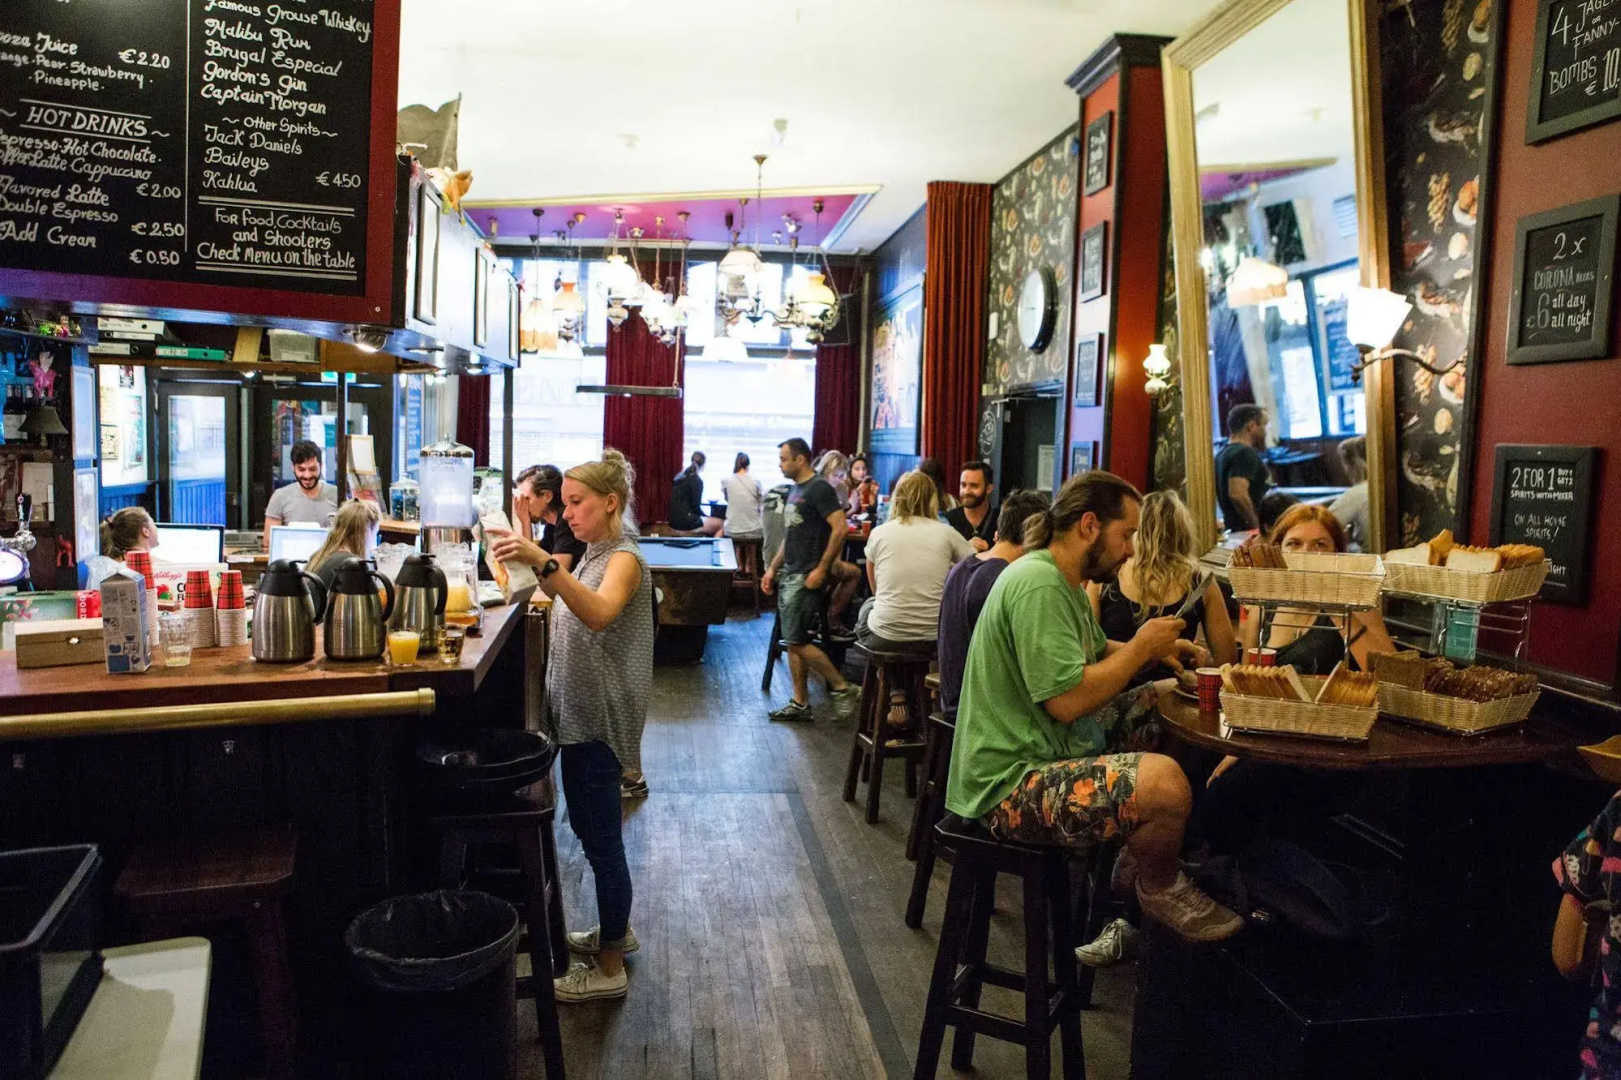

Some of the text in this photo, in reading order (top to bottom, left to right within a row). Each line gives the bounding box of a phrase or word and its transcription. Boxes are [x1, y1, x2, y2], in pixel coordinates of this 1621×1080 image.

[204, 18, 263, 42] Malibu
[205, 0, 371, 43] Famous Grouse Whiskey
[1551, 0, 1614, 45] 4 JAGE
[34, 32, 78, 55] Juice
[205, 39, 342, 76] Brugal Especial
[0, 51, 144, 89] ange Pear Strawberry
[35, 71, 99, 91] Pineapple
[203, 60, 307, 96] Gordon's Gin
[1550, 56, 1597, 95] BOMBS
[200, 83, 326, 117] Captain Morgan
[27, 106, 148, 136] HOT DRINKS
[244, 116, 320, 137] Other Spirits
[0, 129, 156, 163] spresso Hot Chocolate
[249, 132, 302, 155] Daniels
[29, 150, 67, 171] Latte
[71, 157, 152, 182] Cappuccino
[204, 147, 269, 177] Baileys
[203, 170, 257, 193] Kahlua
[66, 184, 109, 206] Latte
[52, 202, 118, 224] Espresso
[276, 215, 341, 234] Cocktails
[0, 220, 97, 248] Add Cream
[233, 227, 331, 250] and Shooters
[1553, 232, 1566, 260] 2
[197, 242, 355, 268] Check Menu on the table
[1534, 266, 1575, 290] CORONA
[1552, 293, 1586, 312] all day
[1551, 309, 1591, 333] all night
[1511, 467, 1555, 490] 2 FOR 1
[1510, 489, 1535, 500] SPIRITS
[1550, 565, 1567, 576] IGHT
